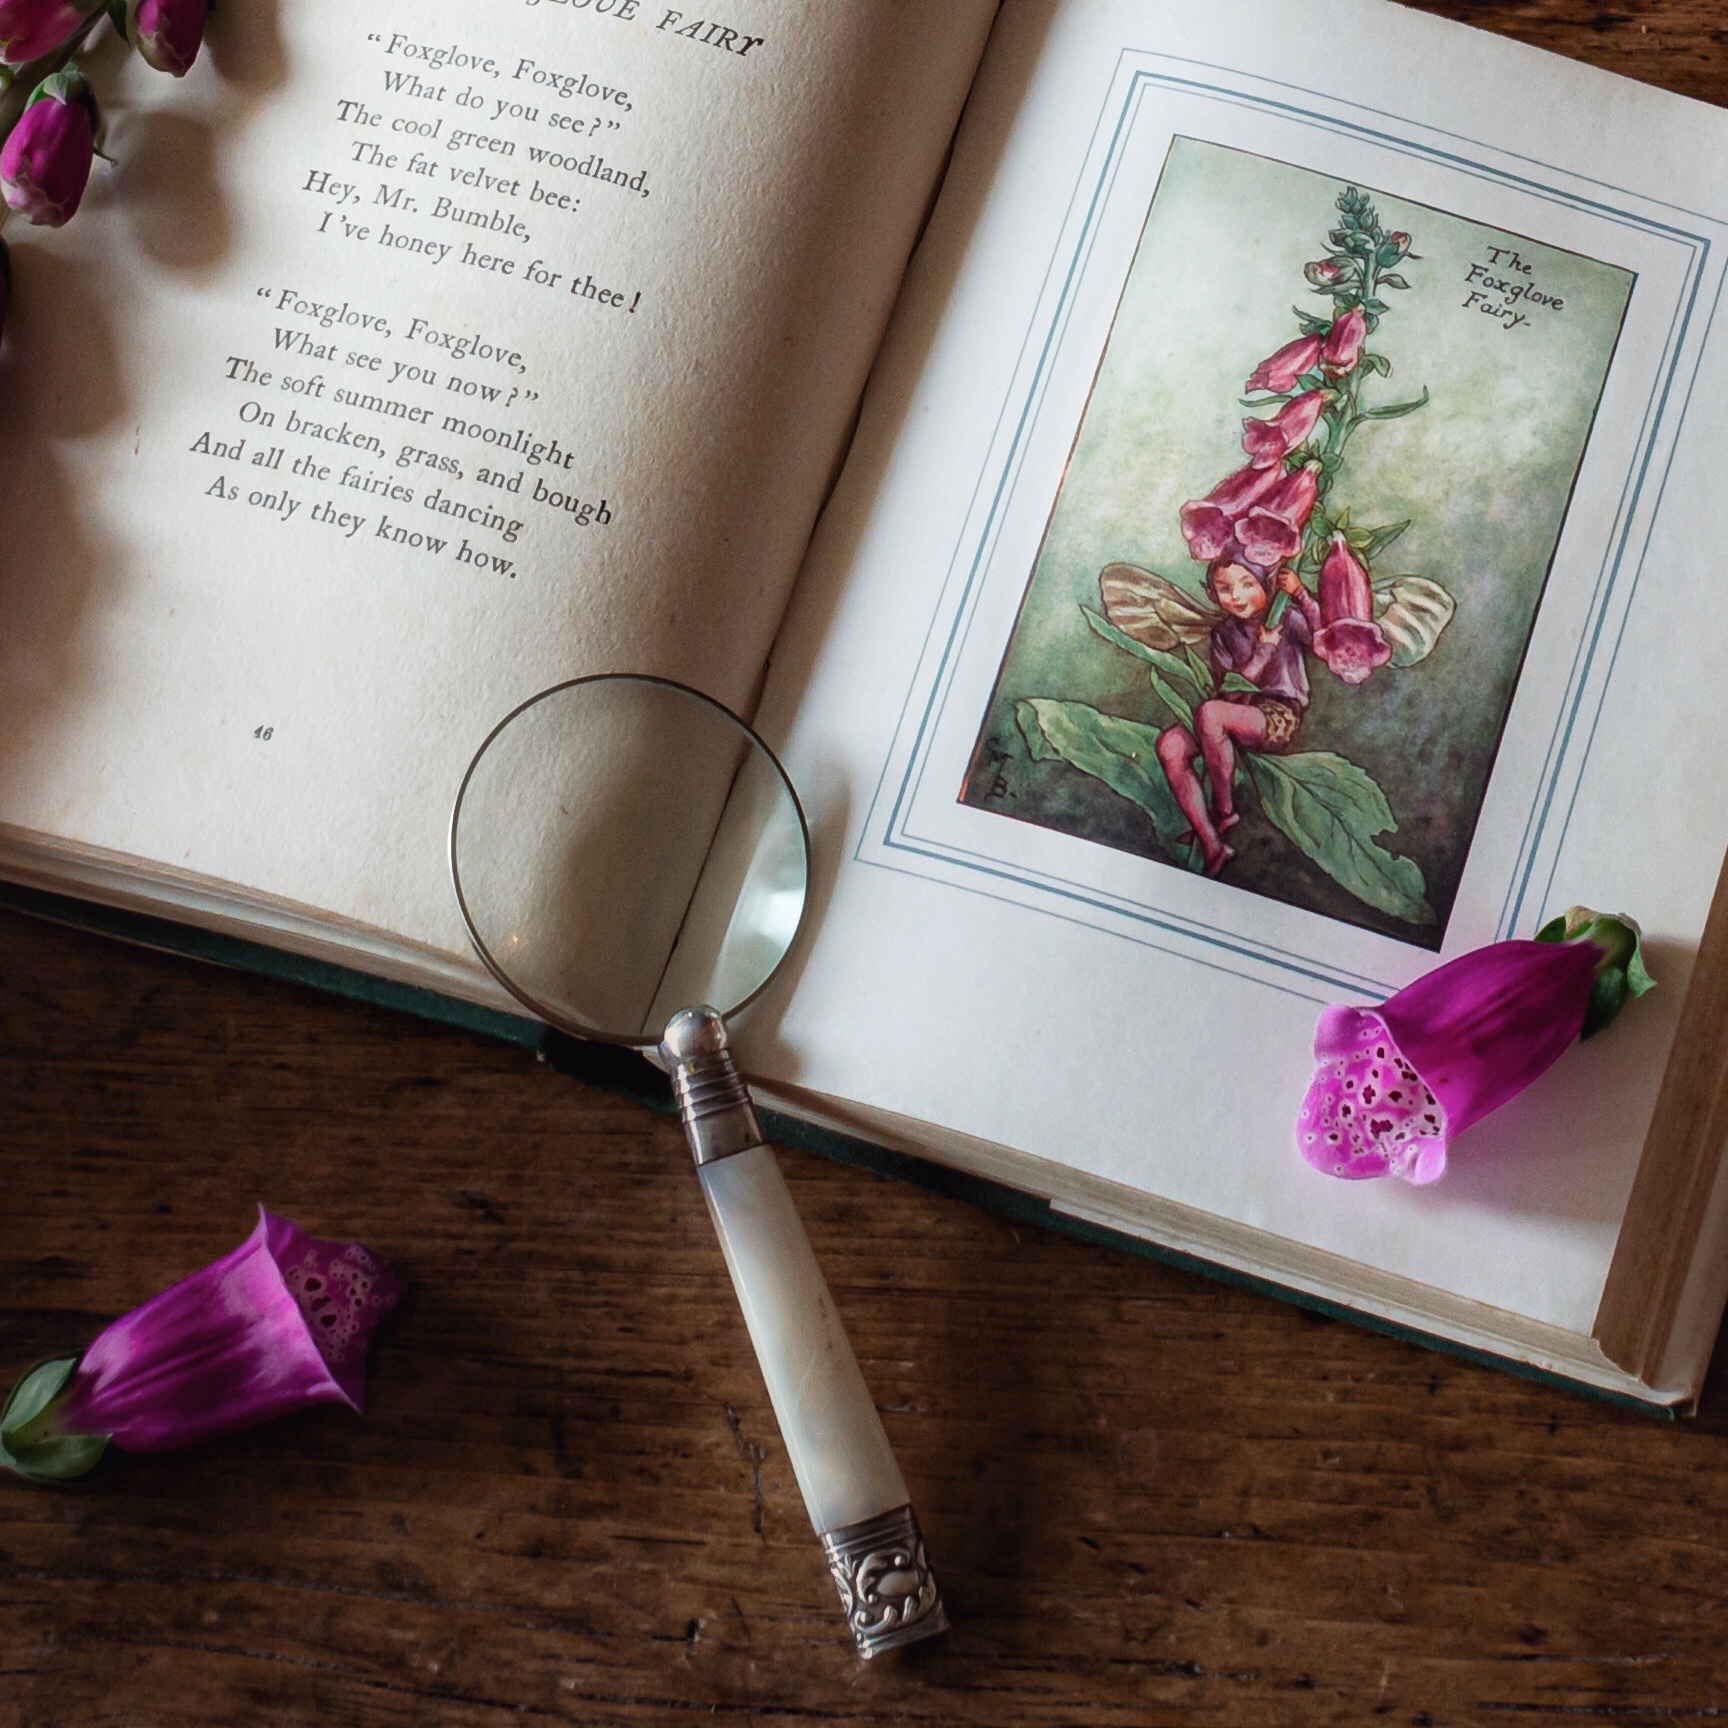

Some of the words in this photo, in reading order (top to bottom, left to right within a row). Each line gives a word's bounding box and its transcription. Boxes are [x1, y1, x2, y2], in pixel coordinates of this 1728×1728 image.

[655, 8, 765, 57] FAIRY
[383, 70, 448, 102] What
[455, 85, 485, 110] do
[489, 99, 540, 122] you
[511, 58, 633, 113] Foxglove,
[336, 98, 383, 127] The
[391, 118, 443, 139] cool
[446, 129, 516, 157] green
[528, 146, 650, 199] woodland,
[351, 140, 398, 169] The
[405, 152, 440, 178] fat
[449, 166, 521, 197] velvet
[528, 179, 581, 213] bee:
[301, 169, 361, 205] Hey,
[372, 183, 418, 214] Mr.
[430, 196, 531, 244] Bumble,
[377, 223, 454, 266] honey
[459, 242, 515, 275] here
[522, 259, 563, 288] for
[570, 275, 642, 314] thee!
[1464, 263, 1565, 311] Foxglove
[1487, 245, 1533, 276] The
[274, 327, 339, 362] What
[345, 351, 383, 372] see
[386, 361, 437, 386] you
[404, 317, 527, 375] Foxglove,
[225, 355, 273, 387] The
[280, 374, 326, 398] soft
[333, 388, 435, 425] summer
[440, 416, 575, 470] moonlight
[188, 431, 247, 461] And
[251, 446, 286, 470] all
[291, 454, 331, 481] the
[338, 465, 415, 503] fairies
[423, 488, 525, 544] dancing
[238, 401, 276, 428] On
[284, 409, 386, 459] bracken,
[395, 445, 464, 481] grass,
[475, 467, 525, 494] and
[531, 477, 612, 527] bough
[204, 475, 240, 501] As
[247, 490, 303, 522] only
[310, 500, 367, 539] they
[374, 514, 449, 555] know
[454, 538, 517, 580] how.
